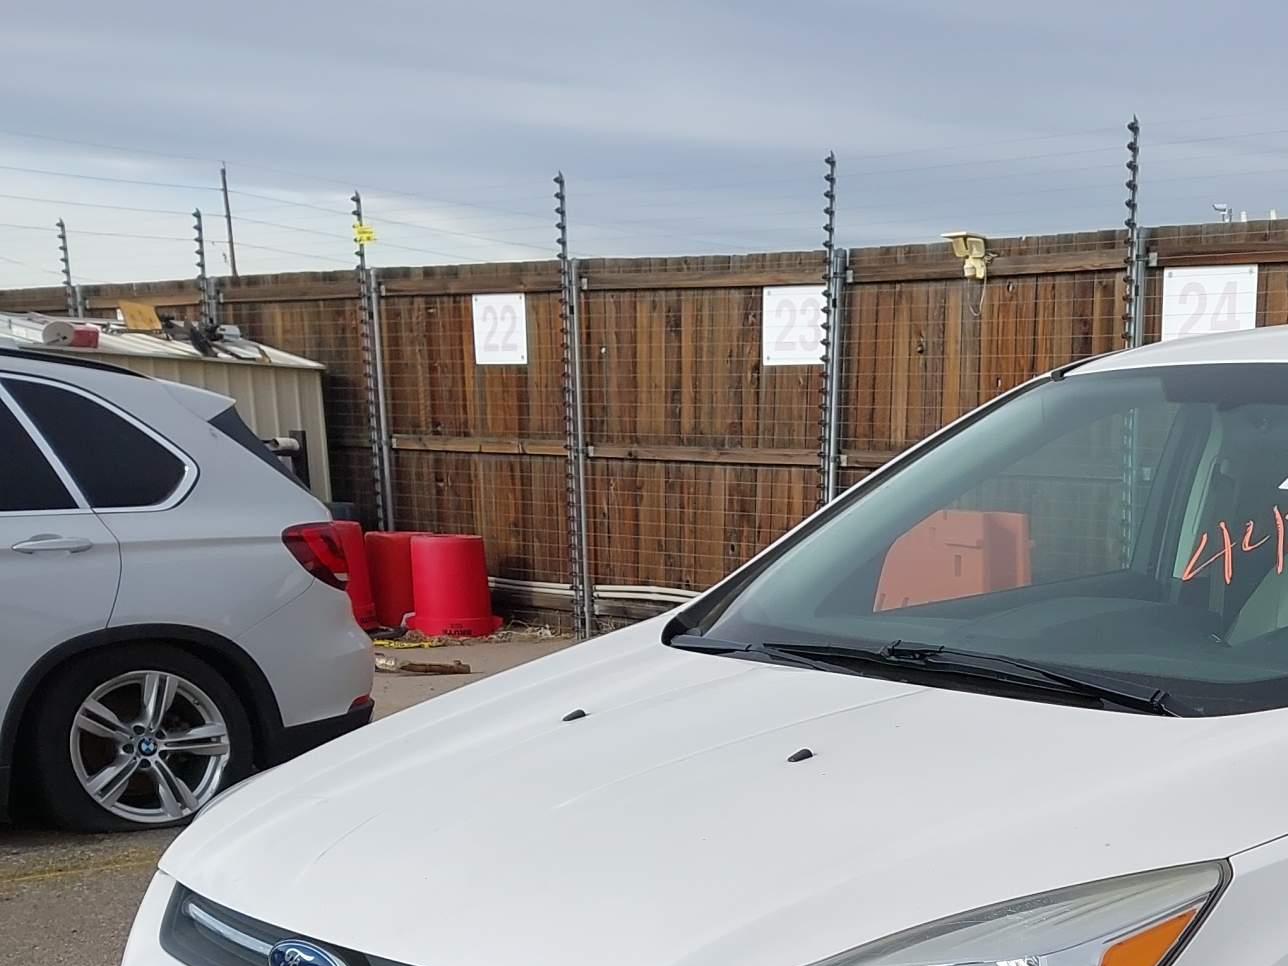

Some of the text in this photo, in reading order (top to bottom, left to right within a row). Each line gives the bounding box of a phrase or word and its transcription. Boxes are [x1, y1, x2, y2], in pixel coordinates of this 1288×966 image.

[481, 304, 518, 353] 22
[774, 297, 821, 352] 23
[1178, 281, 1241, 338] 24
